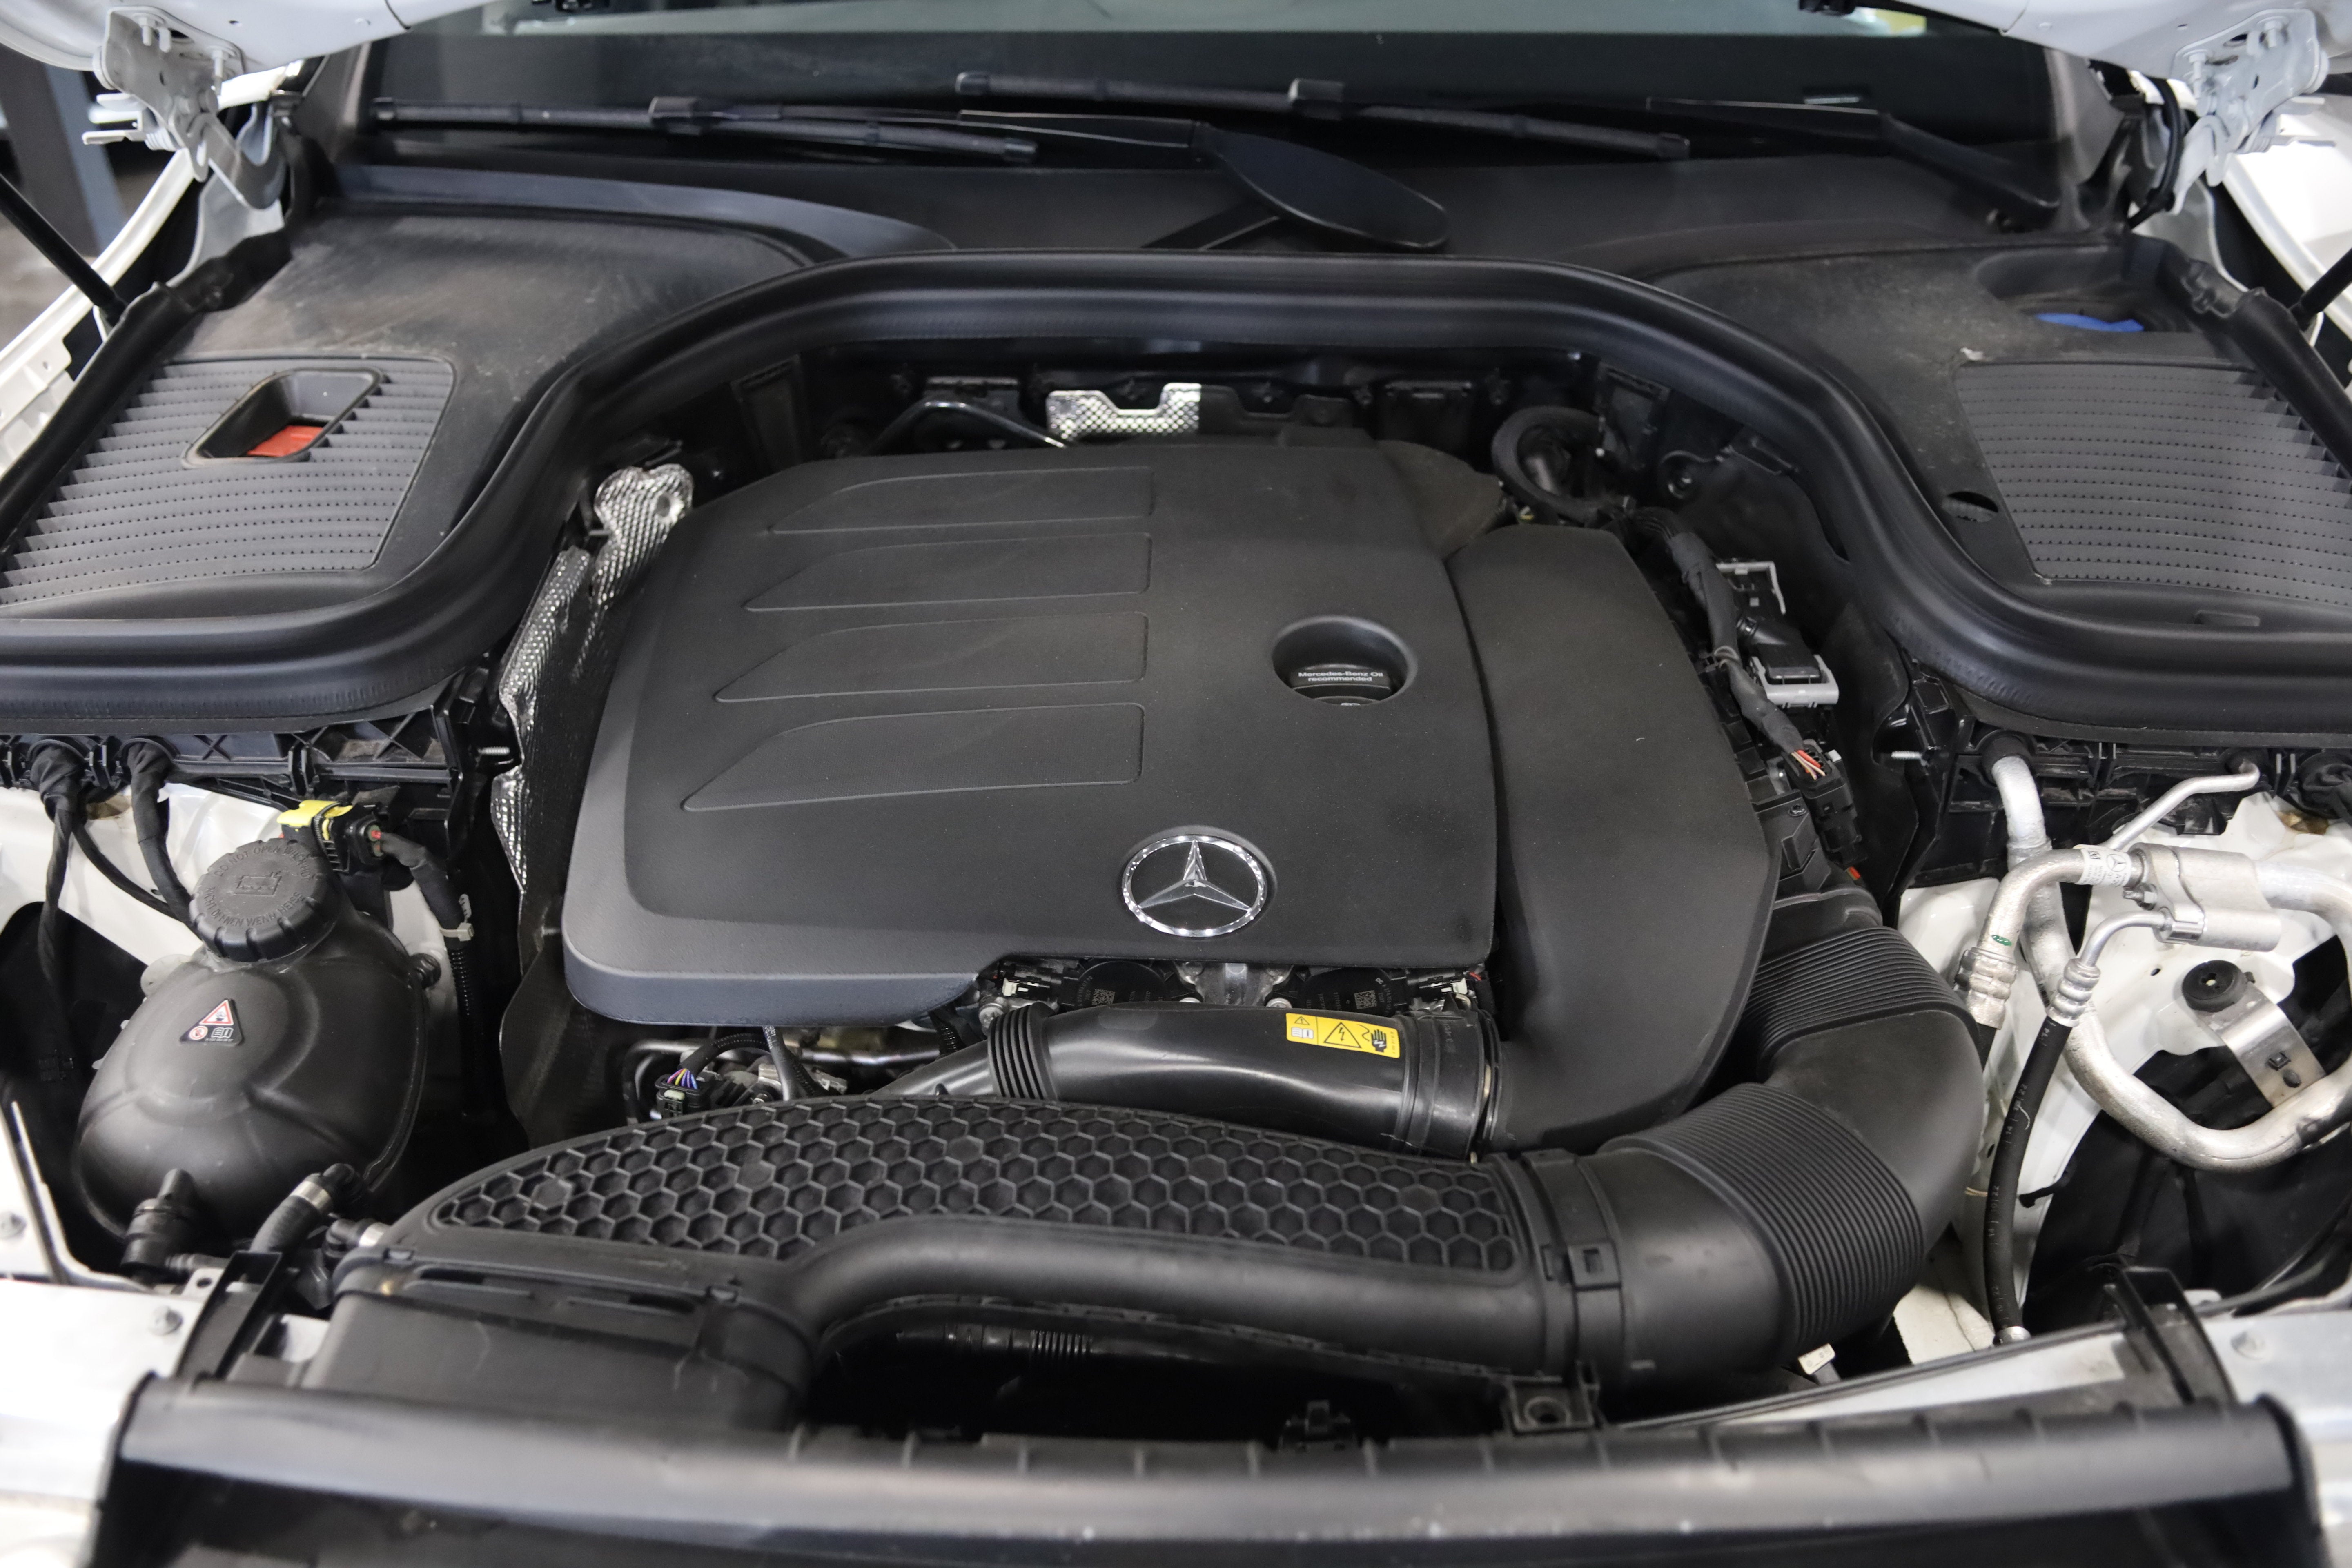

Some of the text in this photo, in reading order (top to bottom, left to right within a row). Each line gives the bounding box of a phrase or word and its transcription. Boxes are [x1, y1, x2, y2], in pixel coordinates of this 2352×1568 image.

[214, 864, 228, 877] DO
[228, 851, 249, 864] NOT
[253, 846, 280, 855] OPEN
[204, 887, 216, 910] NICHT
[247, 912, 277, 926] WENN
[276, 891, 305, 916] HEISS
